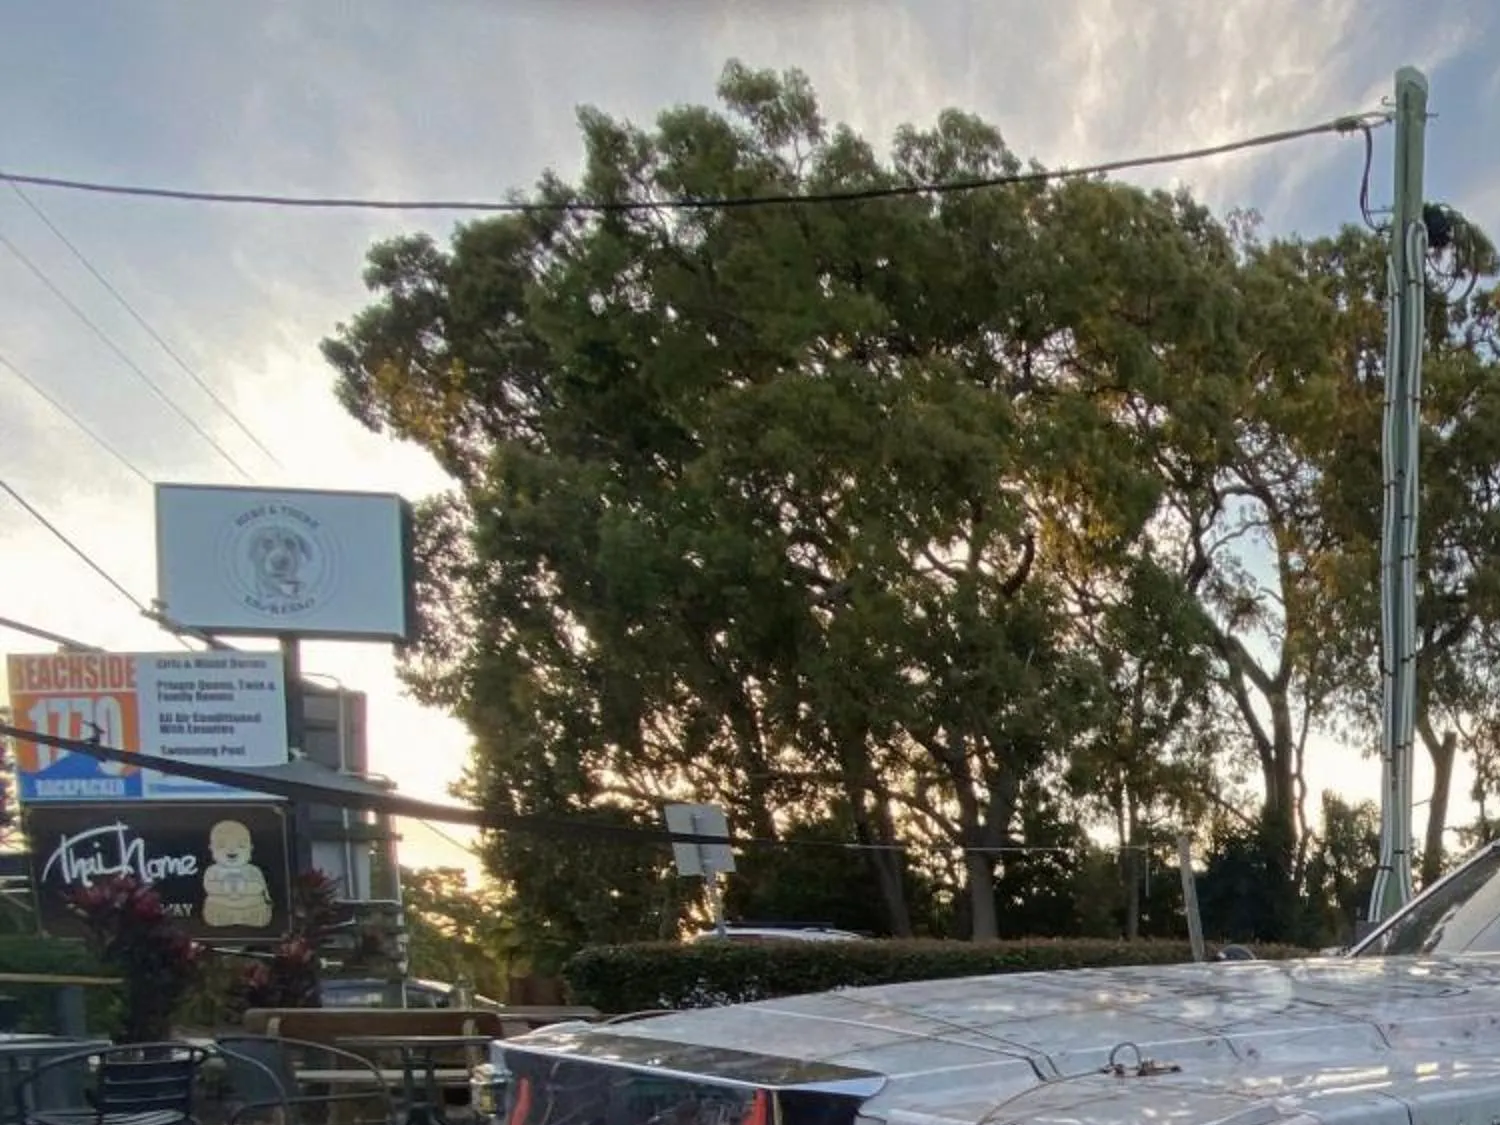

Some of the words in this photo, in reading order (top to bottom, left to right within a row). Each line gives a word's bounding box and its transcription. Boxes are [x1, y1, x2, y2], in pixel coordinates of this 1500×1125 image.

[12, 655, 137, 690] BEACHSIDE
[28, 696, 124, 777] 1770
[192, 712, 262, 722] Conditioned
[40, 824, 122, 887] Thai
